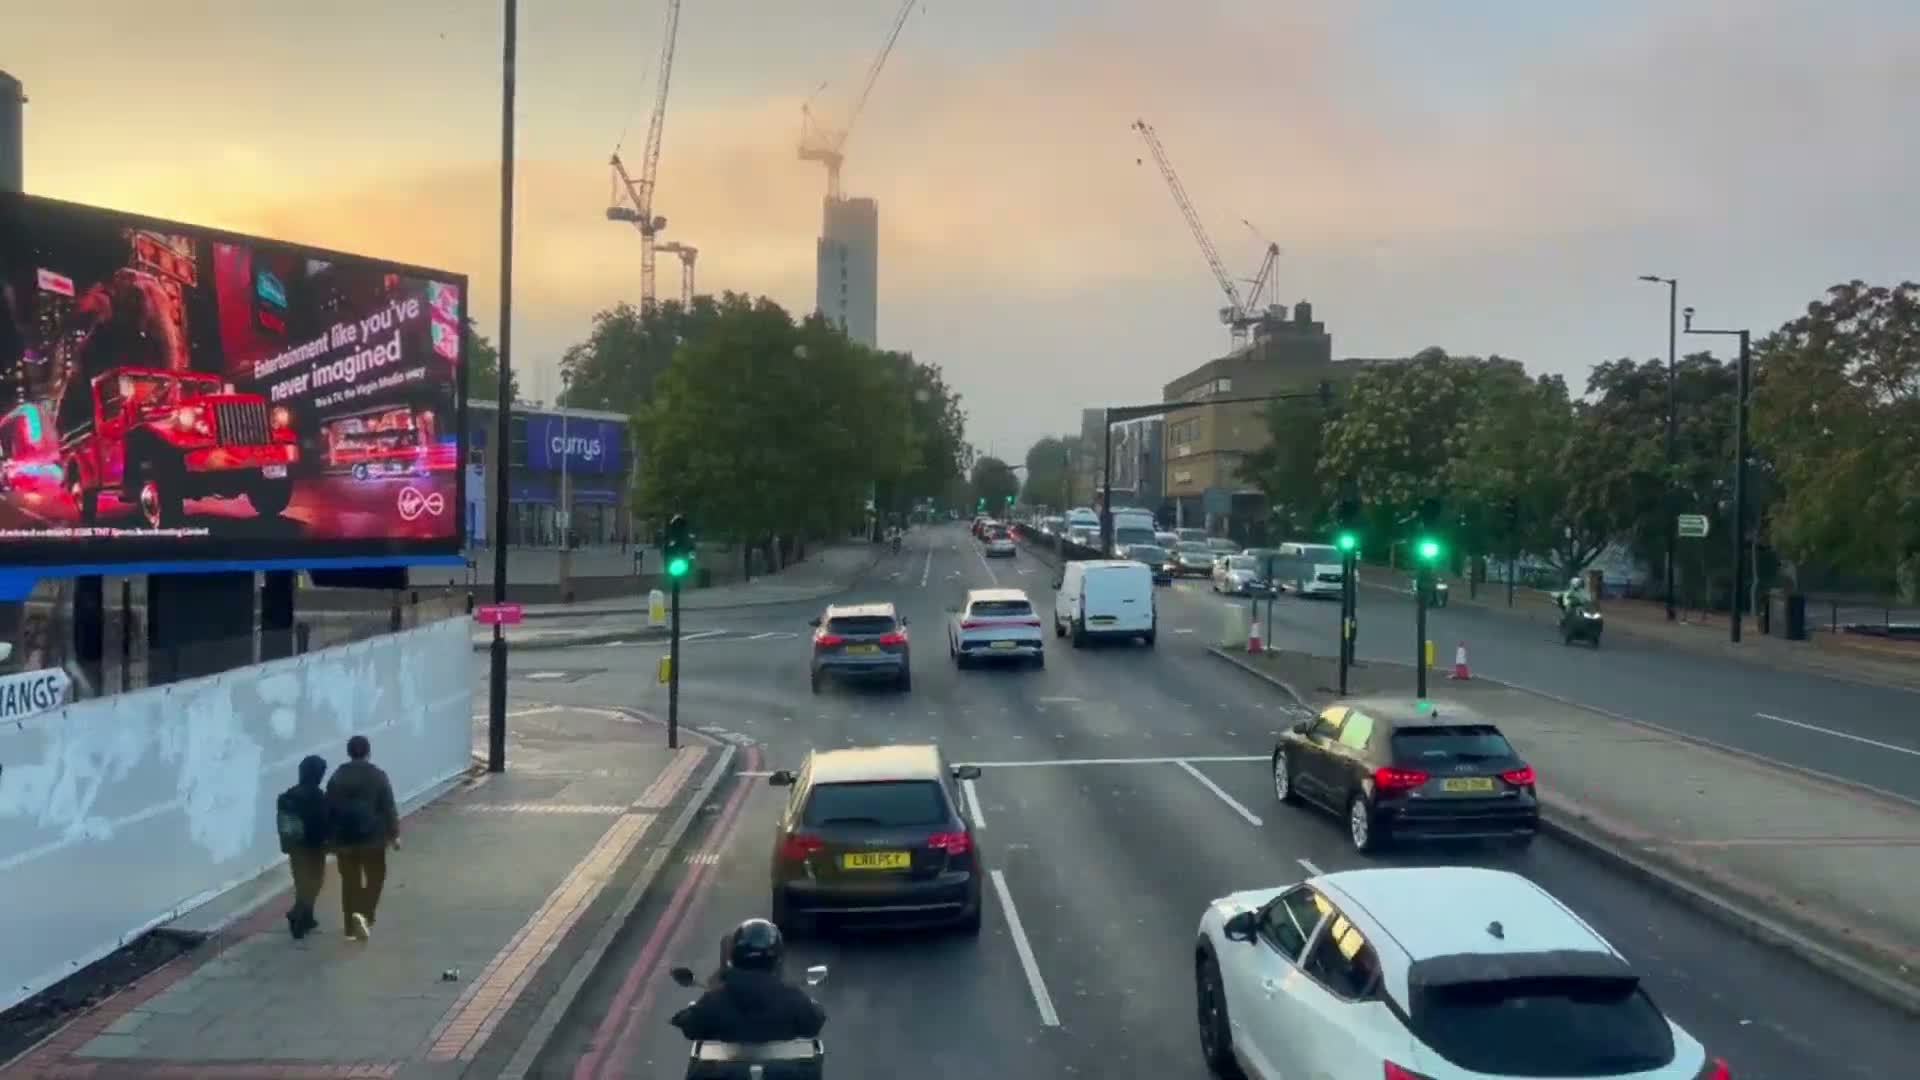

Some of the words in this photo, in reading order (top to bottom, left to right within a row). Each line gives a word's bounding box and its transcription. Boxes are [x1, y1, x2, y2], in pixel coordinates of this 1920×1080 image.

[253, 331, 329, 379] Entertainment
[330, 321, 358, 349] like
[359, 297, 421, 342] you've
[270, 372, 309, 402] never
[311, 329, 402, 387] imagined
[551, 436, 601, 461] currys
